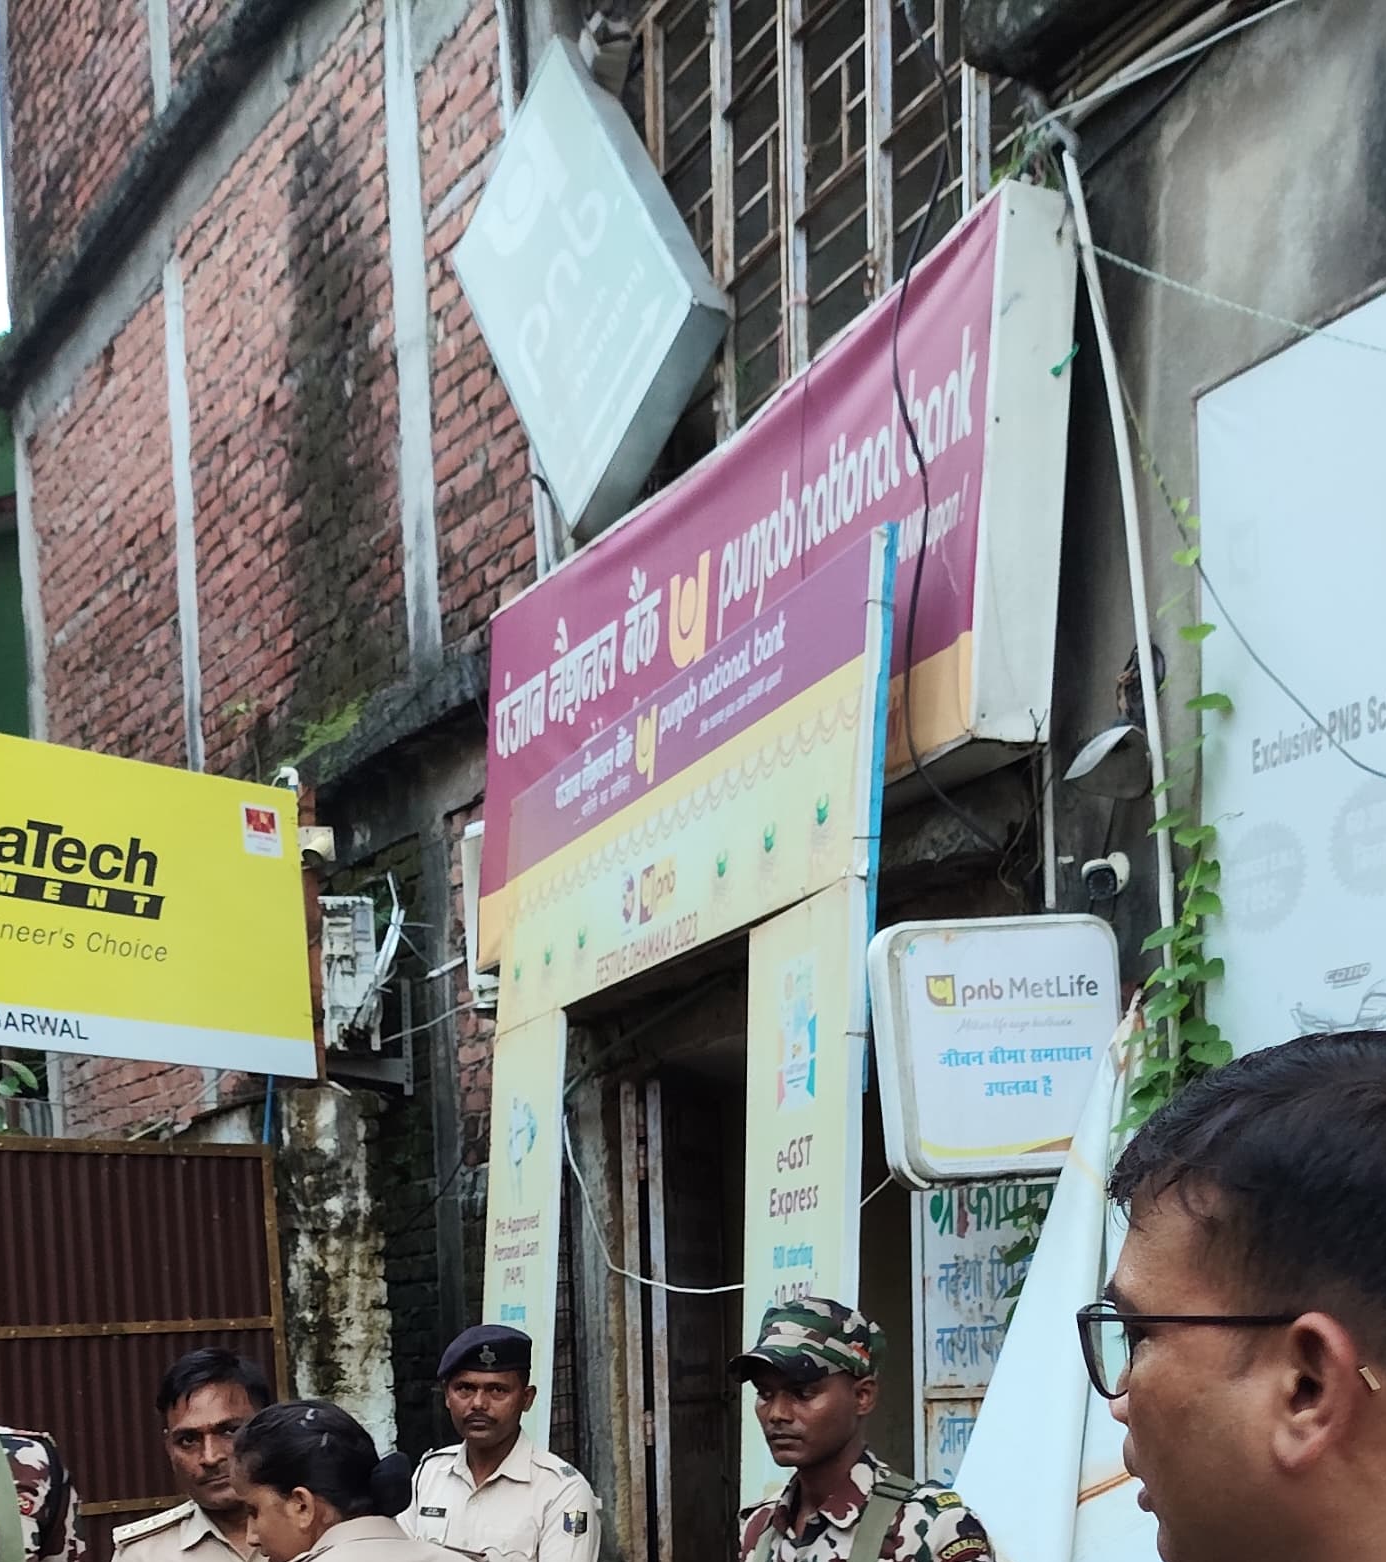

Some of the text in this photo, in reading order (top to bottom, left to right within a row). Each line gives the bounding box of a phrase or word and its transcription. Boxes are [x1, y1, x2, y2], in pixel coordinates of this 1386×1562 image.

[517, 189, 608, 397] pnb
[716, 326, 976, 642] punjab national bank
[495, 671, 547, 759] पंजाब
[622, 565, 662, 676] बैंक
[658, 677, 697, 745] punjab
[699, 640, 751, 707] national
[753, 610, 787, 667] bank
[1251, 722, 1324, 775] Exclusive
[1327, 702, 1362, 751] PNB
[85, 931, 168, 963] Choice
[962, 974, 1099, 1007] pnb MetLife
[939, 1048, 984, 1067] जीवन
[989, 1046, 1027, 1065] बीमा
[776, 1133, 814, 1173] e-GST
[769, 1184, 820, 1224] Express
